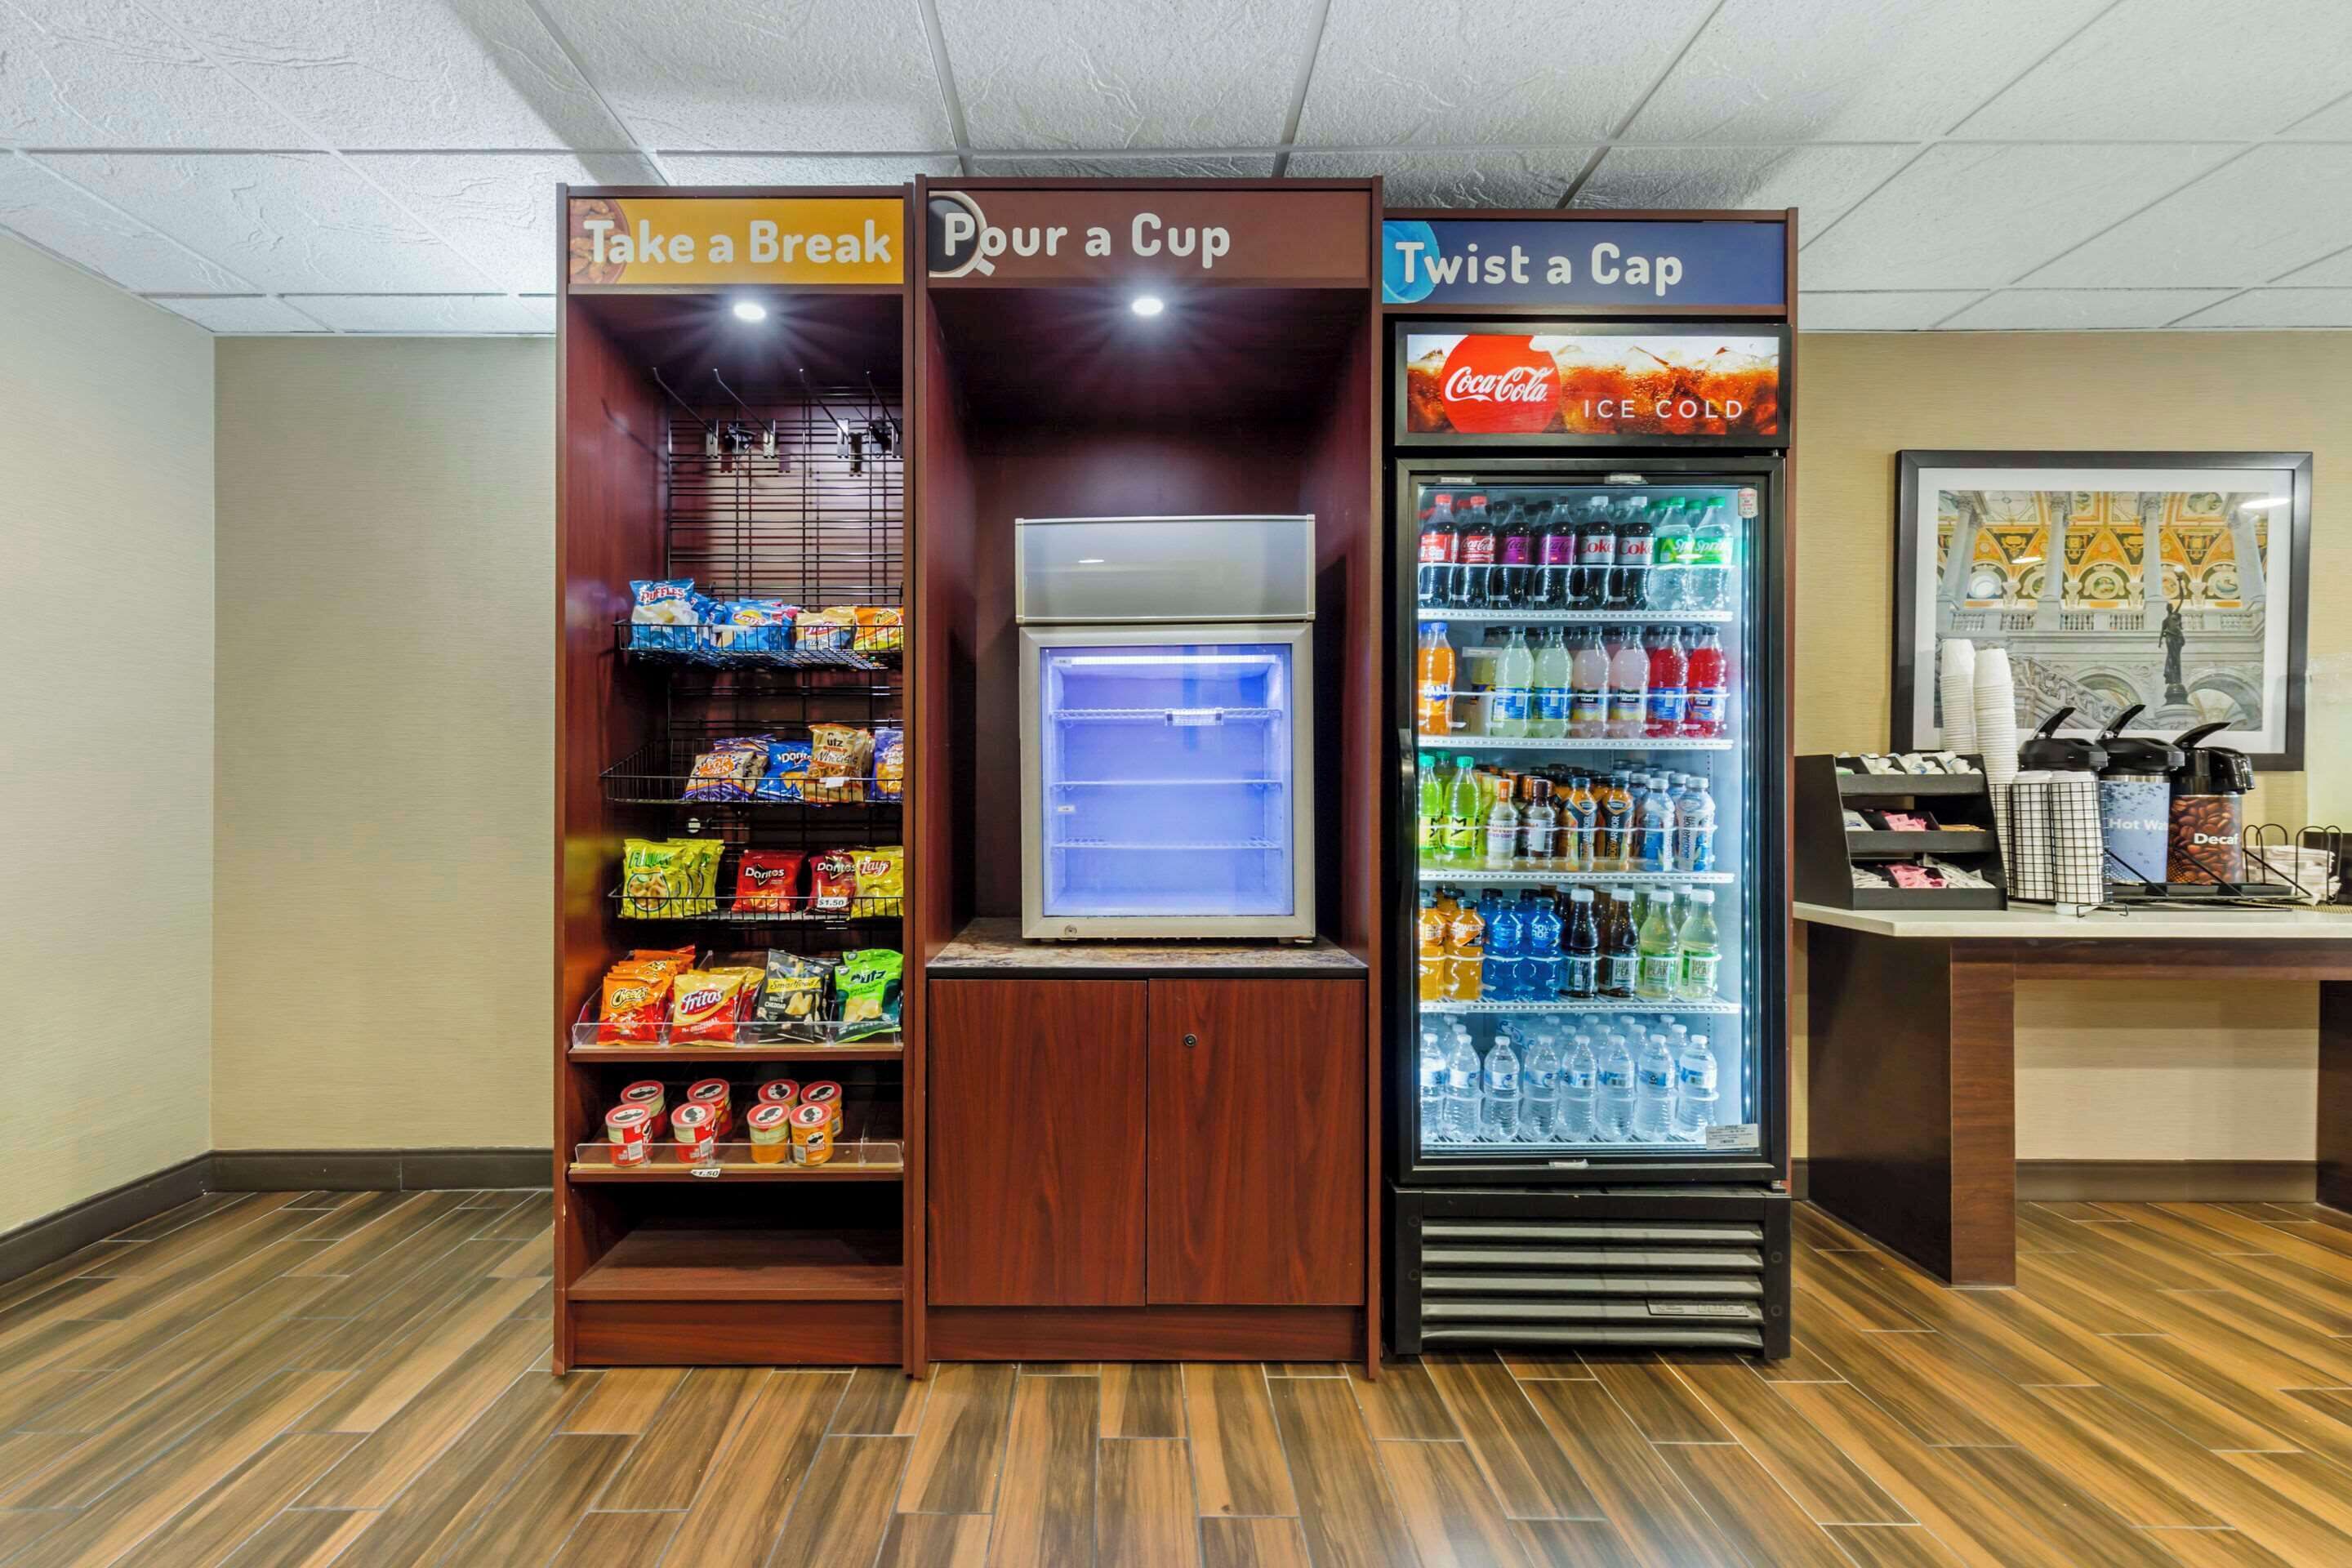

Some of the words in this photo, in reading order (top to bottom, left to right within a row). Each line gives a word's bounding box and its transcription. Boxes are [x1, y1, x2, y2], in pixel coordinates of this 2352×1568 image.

[582, 219, 695, 264] Take
[708, 233, 733, 264] a
[749, 219, 893, 264] Break
[944, 212, 1068, 257] Pour
[1085, 226, 1111, 257] a
[1131, 212, 1231, 269] Cup
[1395, 241, 1530, 285] Twist
[1546, 255, 1572, 285] a
[1591, 242, 1683, 296] Cap
[1444, 365, 1556, 403] Coca-Cola
[1583, 399, 1636, 418] ICE
[1655, 399, 1744, 419] COLD
[639, 586, 686, 604] RUFFLES
[2109, 817, 2140, 830] Hot
[2193, 832, 2239, 844] Decaf
[745, 866, 785, 879] Doritos
[681, 989, 725, 1014] Fritos
